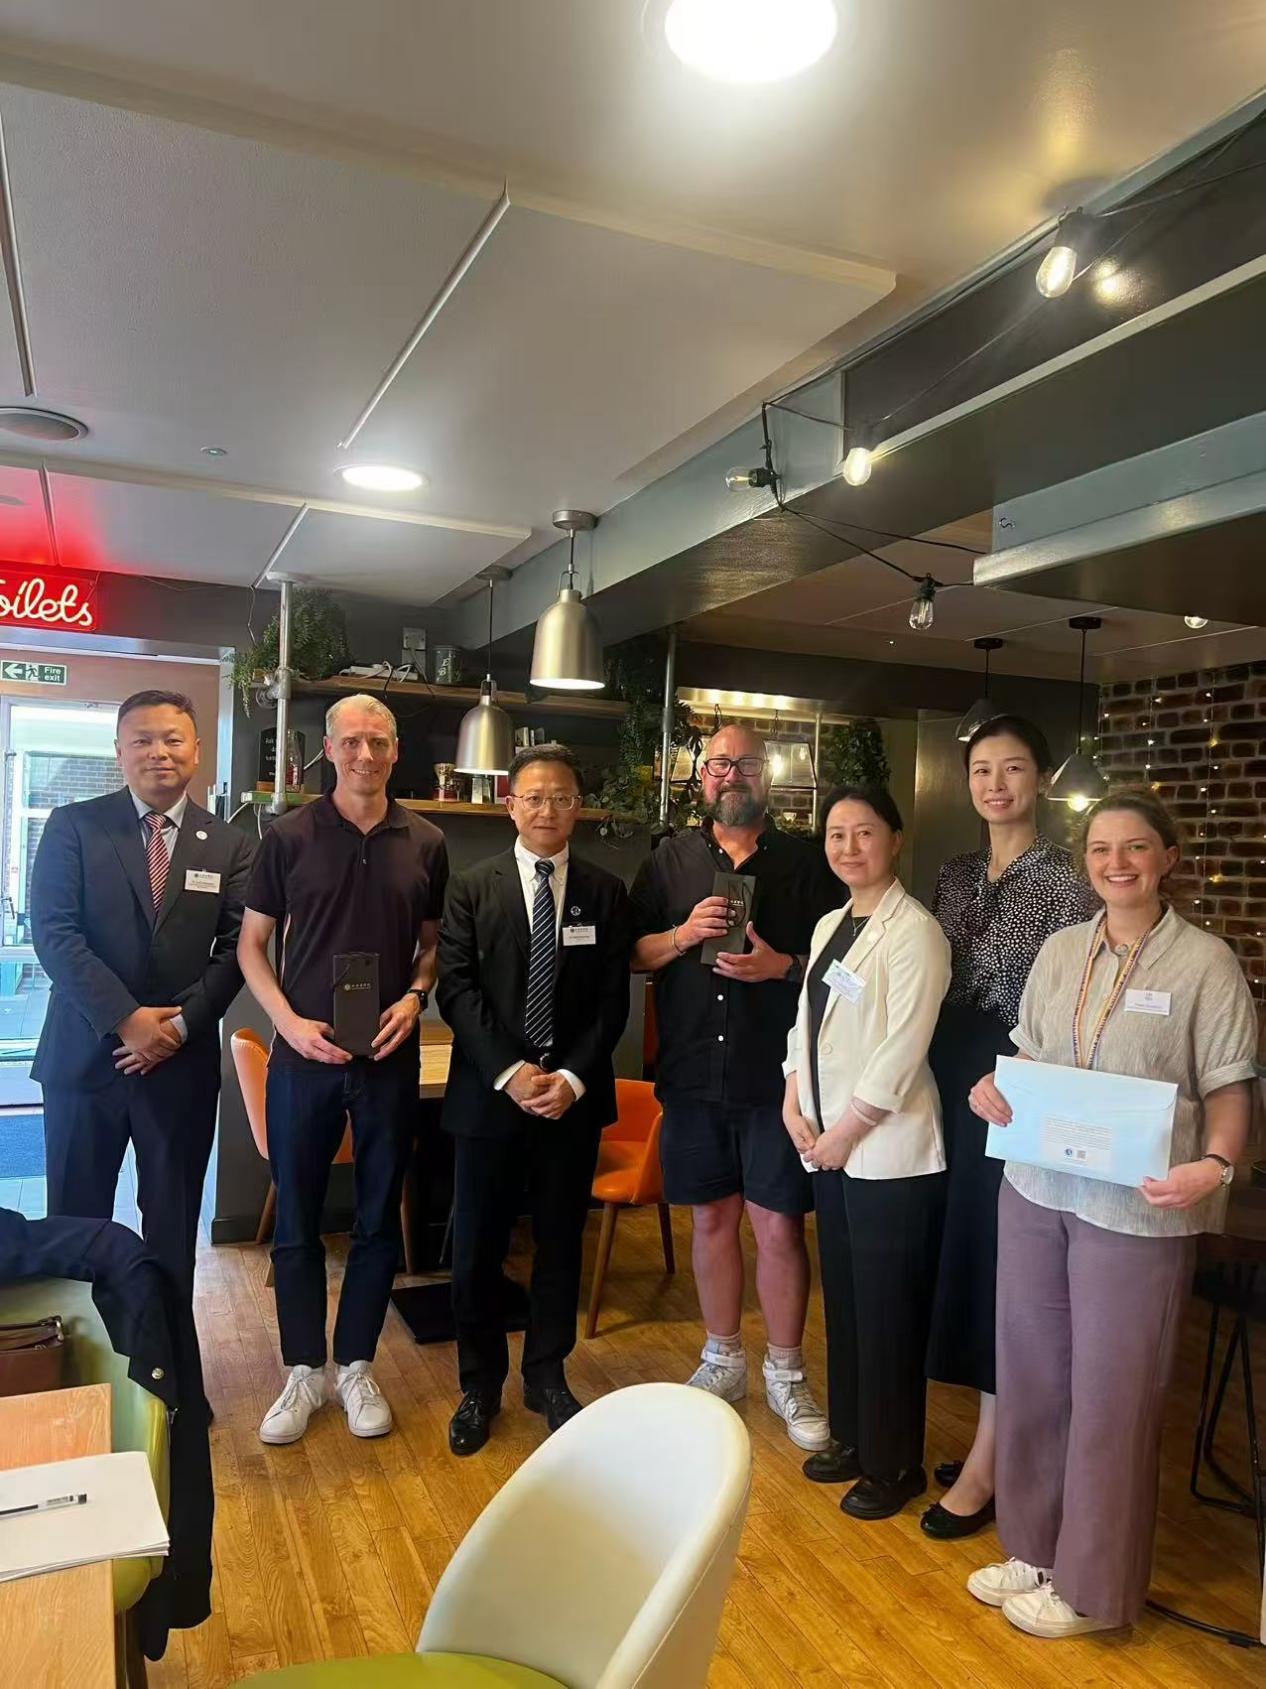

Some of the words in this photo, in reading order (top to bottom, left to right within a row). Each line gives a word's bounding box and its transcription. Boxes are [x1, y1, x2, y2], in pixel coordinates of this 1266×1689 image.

[0, 577, 93, 626] oilets
[44, 666, 62, 675] Fire
[44, 674, 61, 682] exit
